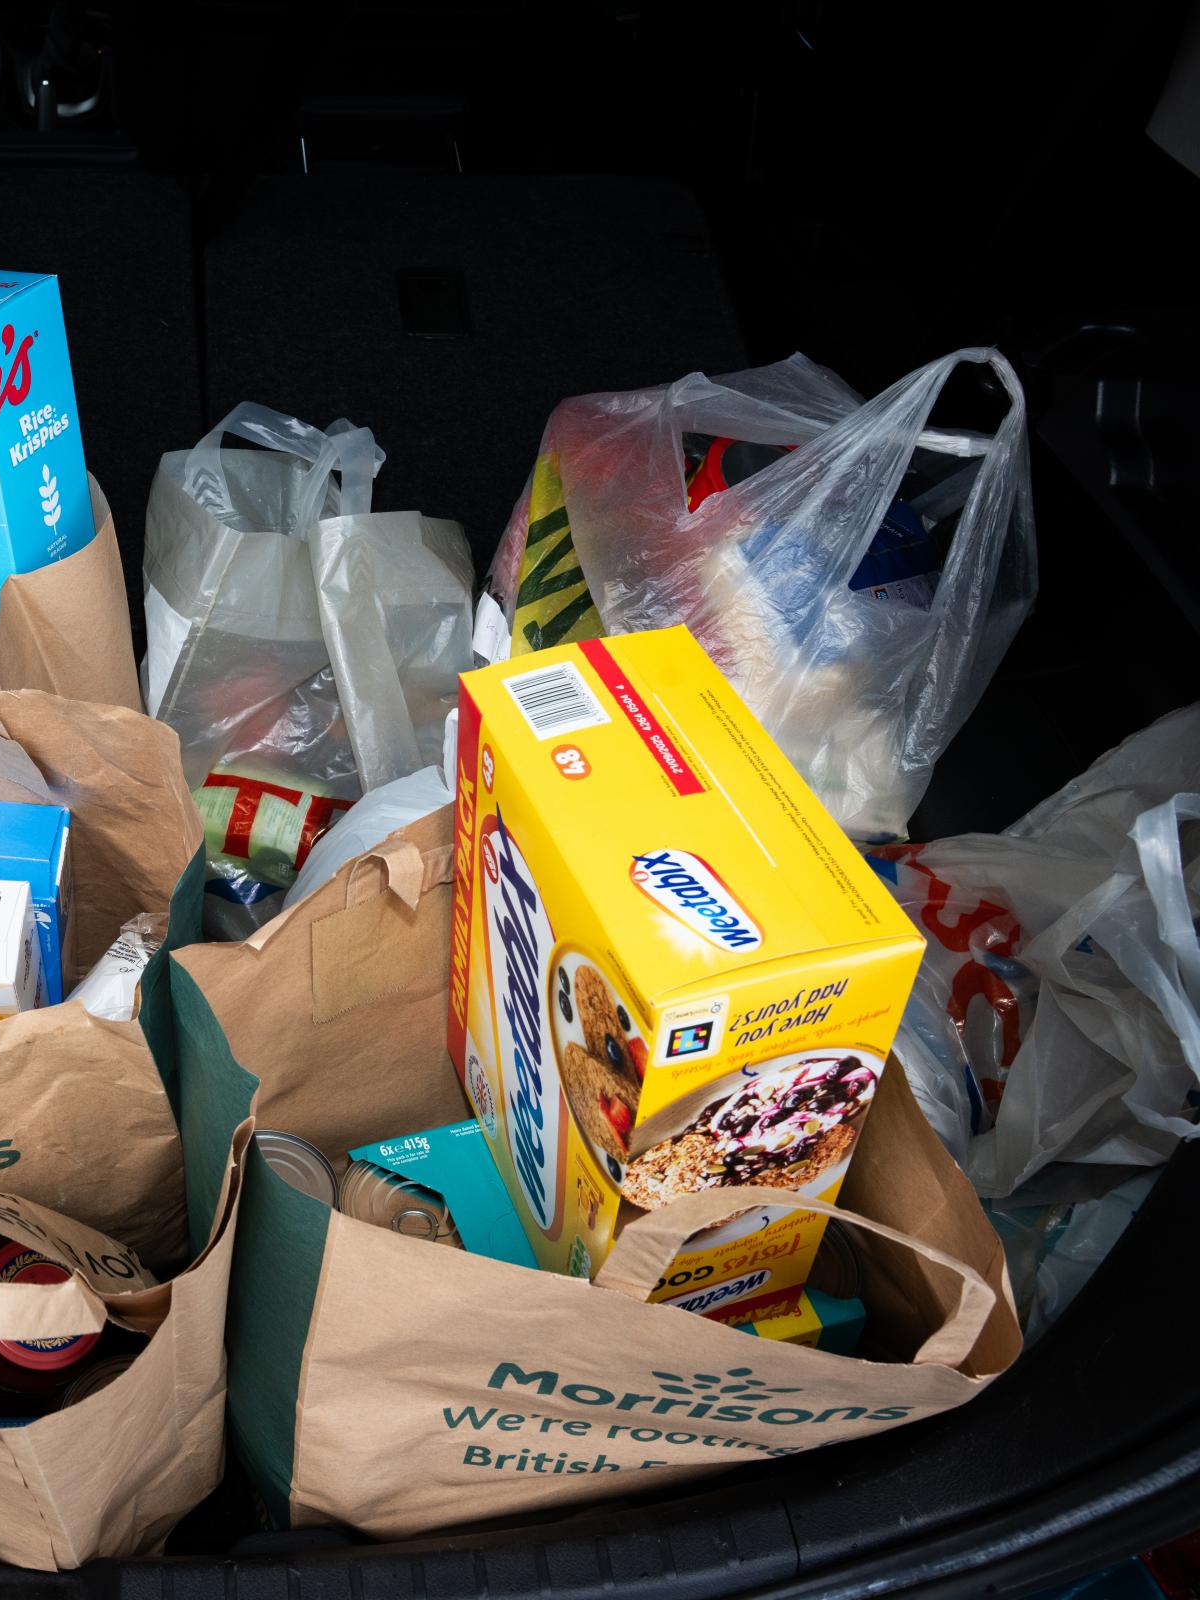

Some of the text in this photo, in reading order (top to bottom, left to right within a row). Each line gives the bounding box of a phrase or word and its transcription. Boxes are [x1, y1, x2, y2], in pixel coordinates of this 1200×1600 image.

[9, 412, 70, 468] Krispies
[19, 404, 53, 436] Rice
[47, 534, 68, 552] NATURAL
[633, 713, 651, 731] 4264
[483, 752, 494, 789] 48
[555, 749, 586, 774] 48
[650, 734, 684, 775] 21/09/2025
[450, 757, 478, 1032] FAMILY PACK
[632, 850, 759, 949] Weetabix
[494, 801, 547, 1227] Weetabix
[728, 978, 849, 1033] had yours?
[735, 1003, 833, 1047] Have you
[721, 1232, 802, 1274] Tastes
[487, 1362, 916, 1425] Morrisons
[443, 1405, 805, 1457] We're rooting
[462, 1445, 621, 1474] British
